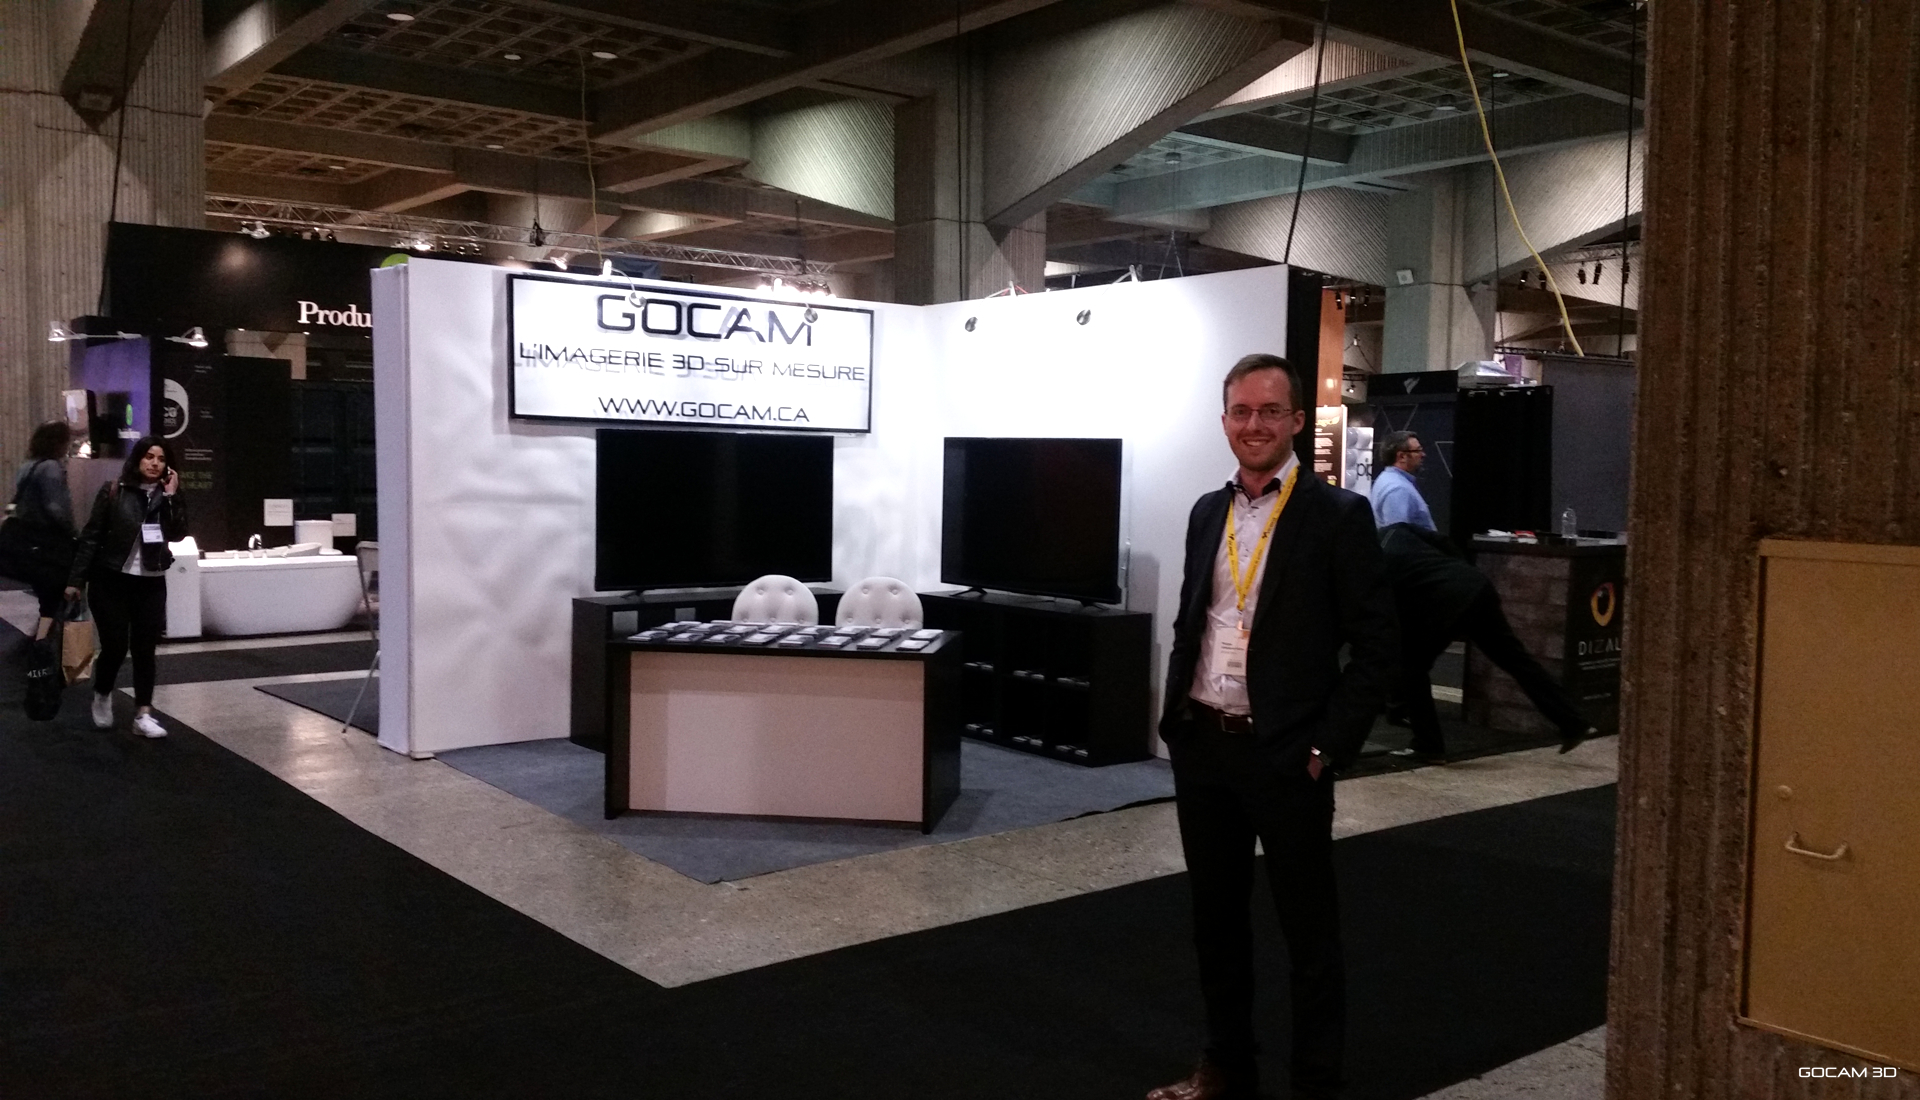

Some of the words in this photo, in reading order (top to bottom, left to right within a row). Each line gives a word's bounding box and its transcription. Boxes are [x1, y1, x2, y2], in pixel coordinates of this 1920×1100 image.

[597, 294, 812, 346] GOCAM
[520, 342, 665, 367] L'IMAGERIE
[673, 354, 705, 370] 3D
[714, 357, 763, 375] SUR
[772, 362, 866, 381] MESURE
[598, 396, 810, 422] WWW.GOCAM.CA
